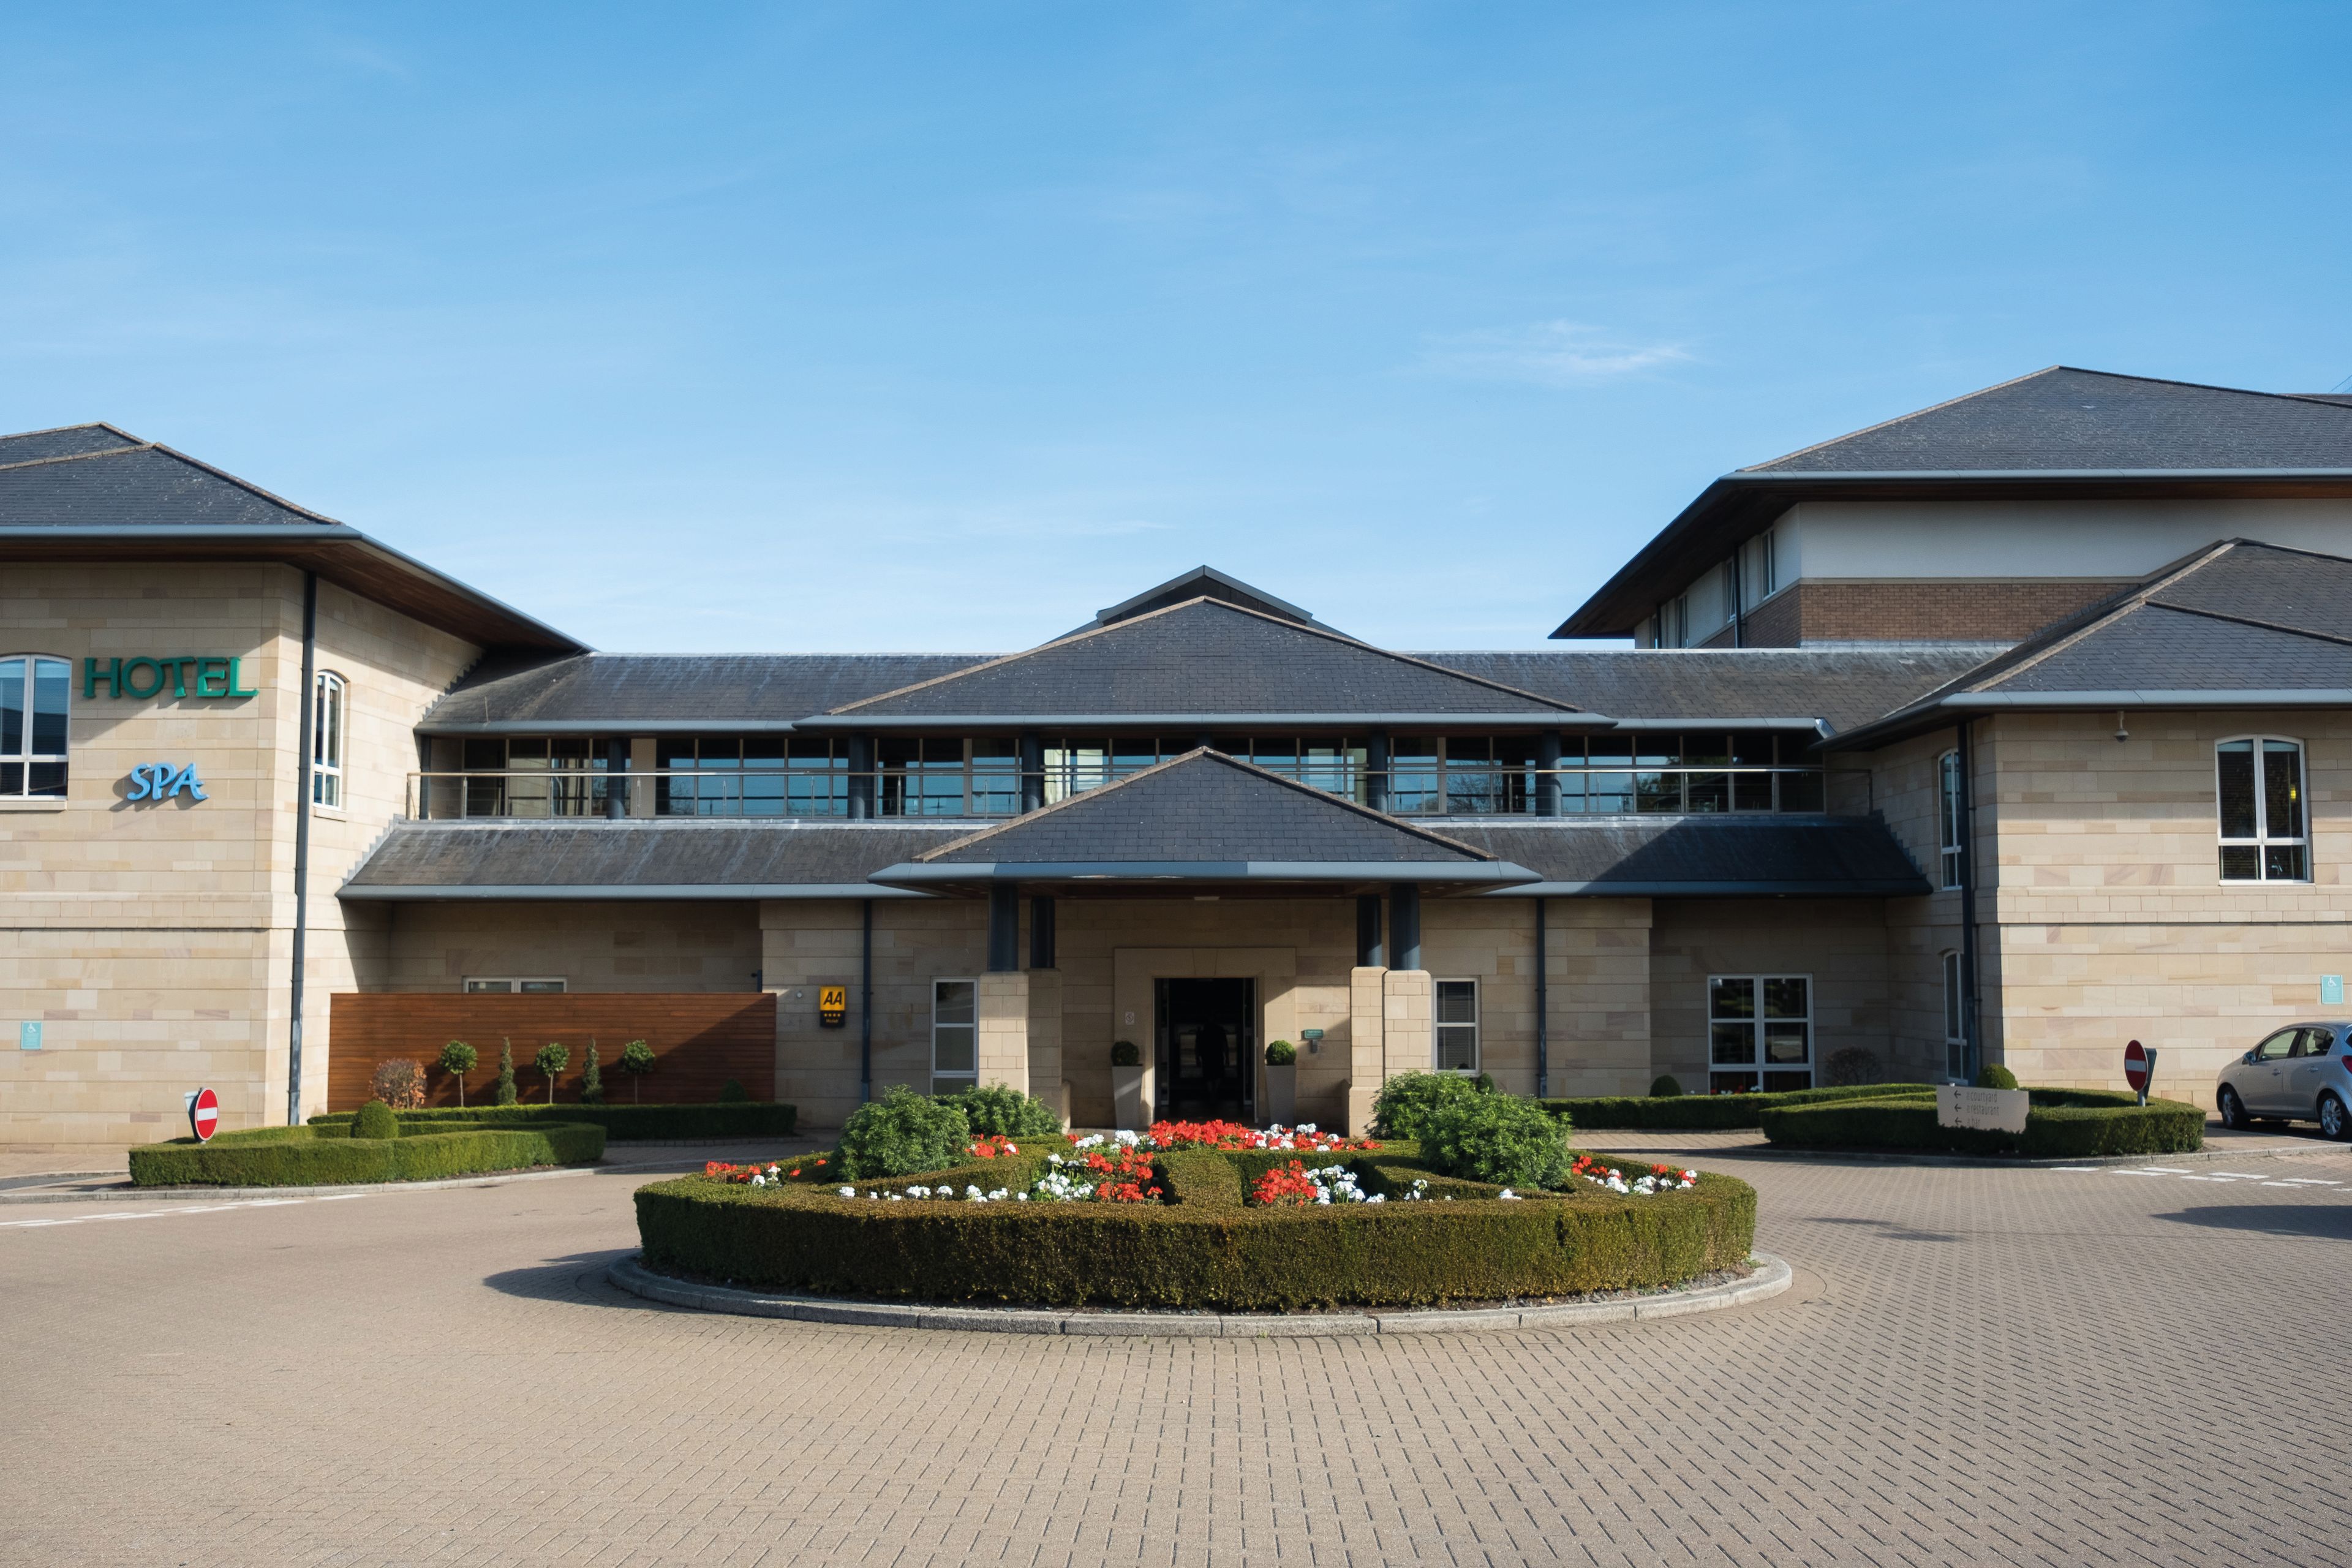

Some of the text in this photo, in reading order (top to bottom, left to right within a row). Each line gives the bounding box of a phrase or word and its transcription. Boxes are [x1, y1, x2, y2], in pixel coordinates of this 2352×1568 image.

[83, 656, 259, 698] HOTEL
[127, 762, 209, 801] SPA
[823, 991, 842, 1005] AA
[1970, 1091, 1997, 1104] courtyard
[1970, 1104, 1999, 1116] restaurant
